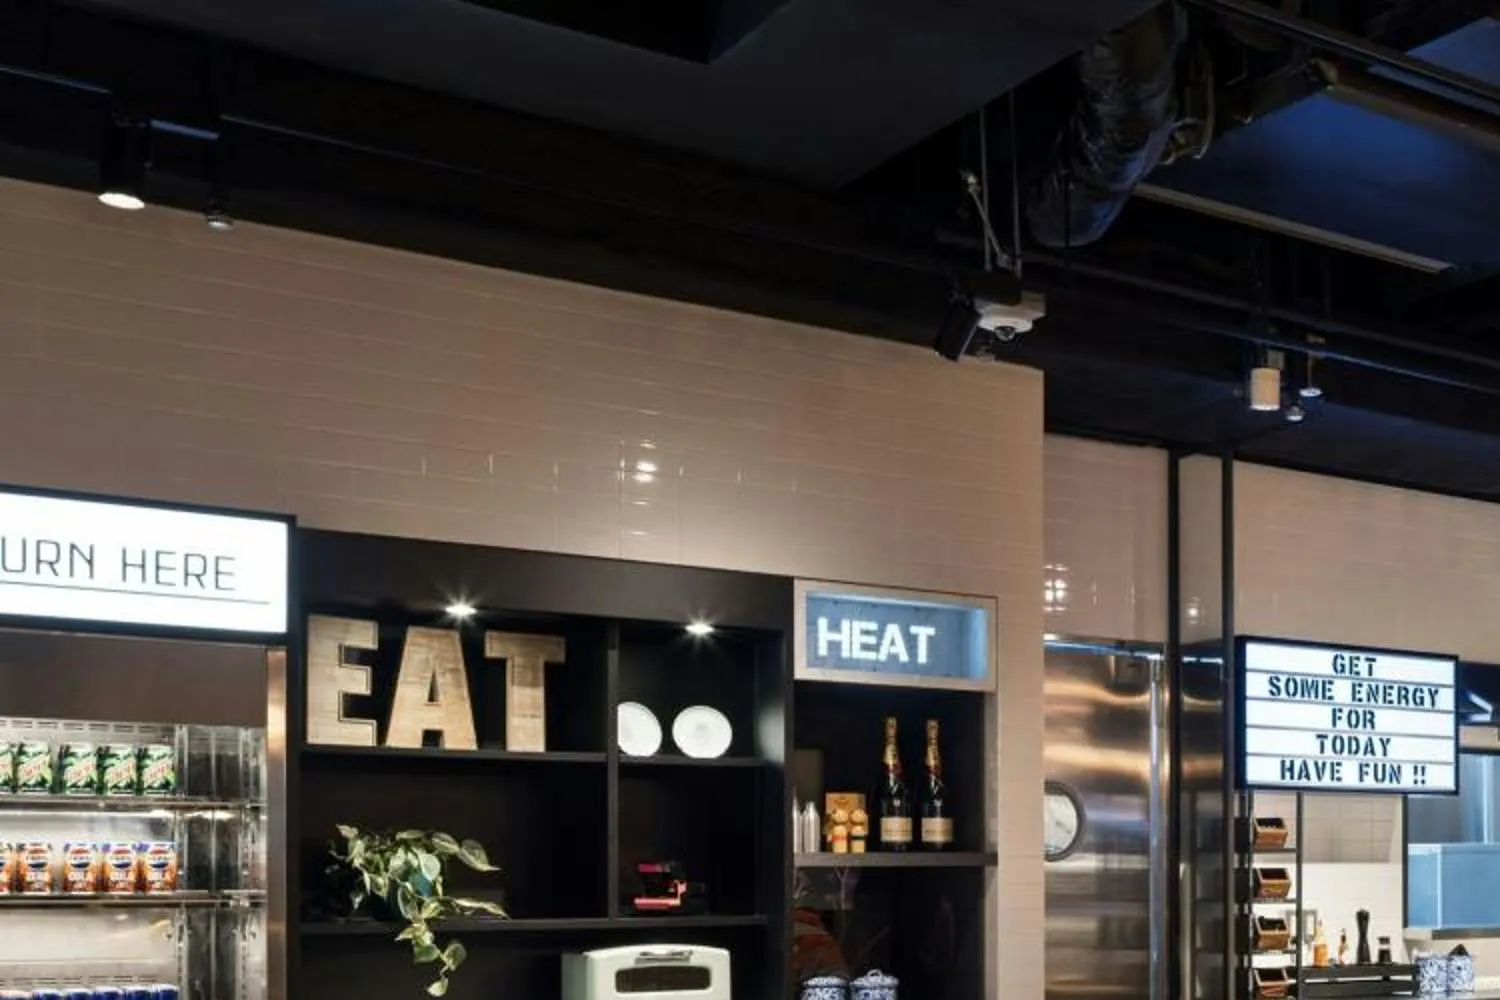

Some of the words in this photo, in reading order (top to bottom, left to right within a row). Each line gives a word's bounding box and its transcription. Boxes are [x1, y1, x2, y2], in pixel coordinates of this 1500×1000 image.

[1, 536, 94, 580] URN
[121, 546, 236, 592] HERE
[817, 616, 936, 665] HEAT
[1332, 653, 1377, 677] GET
[306, 613, 566, 753] EAT
[1267, 675, 1335, 701] SOME
[1351, 682, 1440, 708] ENERGY
[1331, 707, 1376, 729] FOR
[1315, 733, 1392, 757] TODAY
[1280, 759, 1343, 783] HAVE
[1358, 762, 1401, 785] FUN
